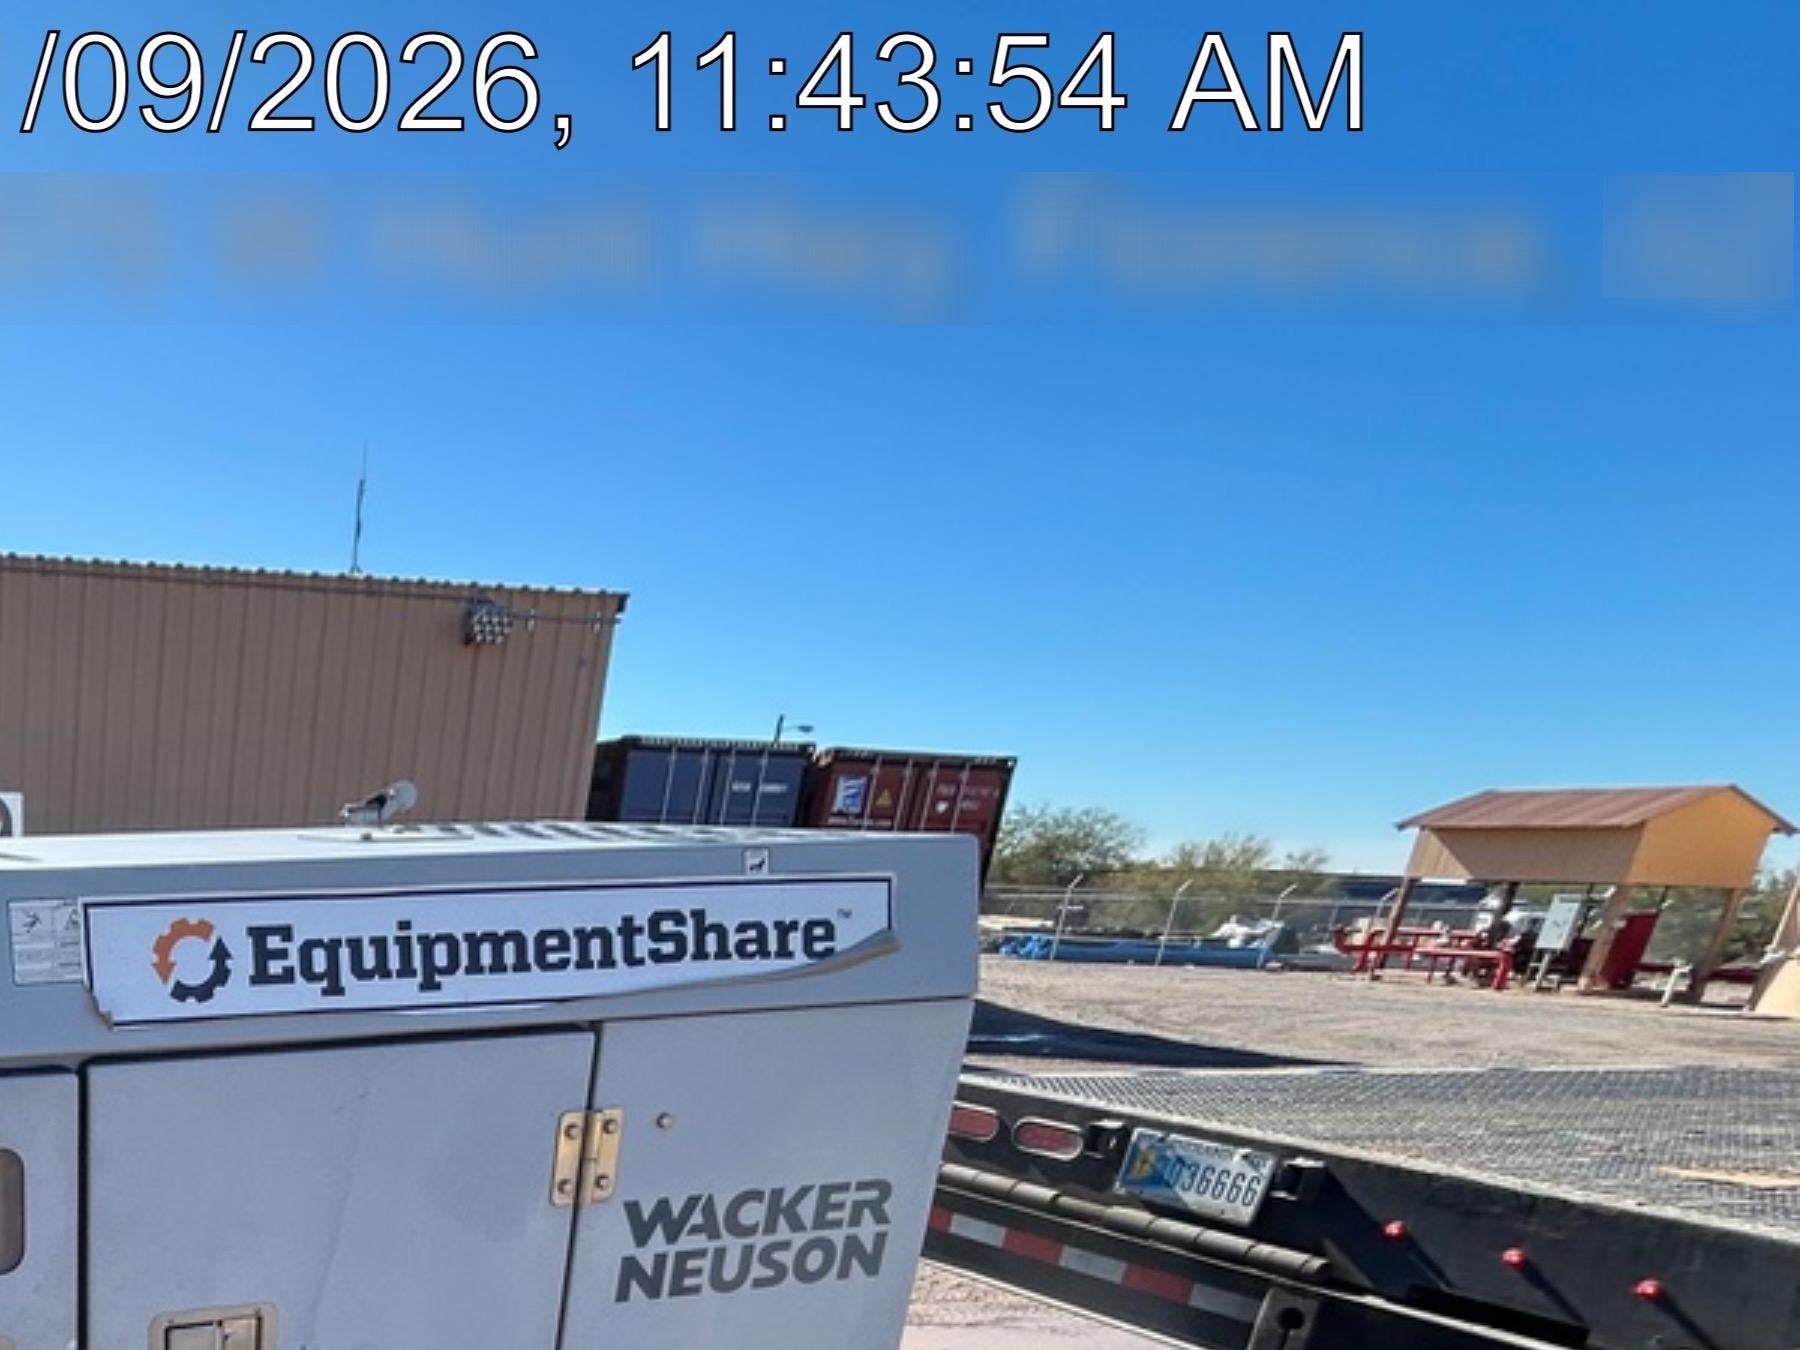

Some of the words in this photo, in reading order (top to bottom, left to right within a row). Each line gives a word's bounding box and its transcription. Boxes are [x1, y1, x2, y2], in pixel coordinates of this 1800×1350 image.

[246, 910, 836, 996] EquipmentShare
[624, 1178, 893, 1248] WACKER
[614, 1232, 889, 1303] NEUSON
